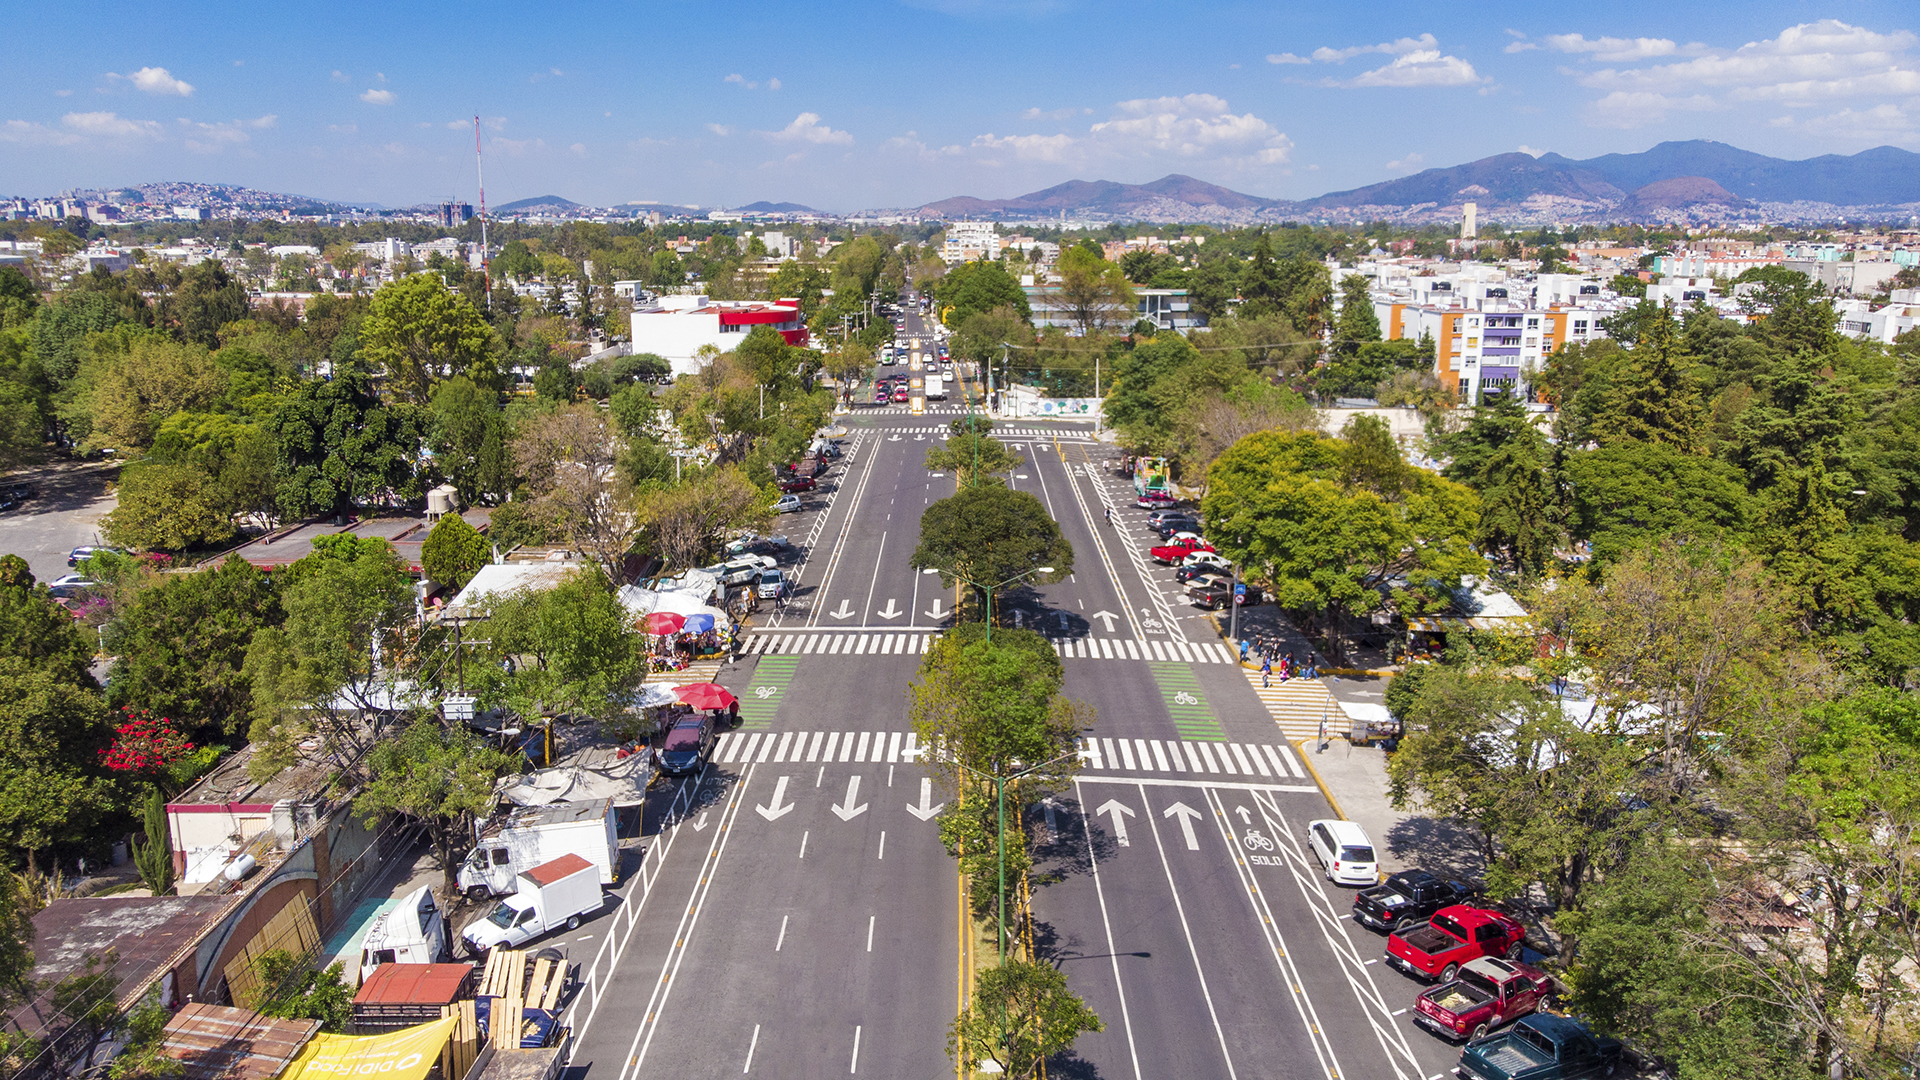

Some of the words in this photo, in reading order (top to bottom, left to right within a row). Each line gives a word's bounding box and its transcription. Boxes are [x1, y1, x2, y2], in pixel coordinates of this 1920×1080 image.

[1250, 855, 1283, 866] SOLO
[305, 1060, 352, 1075] Food
[354, 1060, 394, 1075] DiDi
